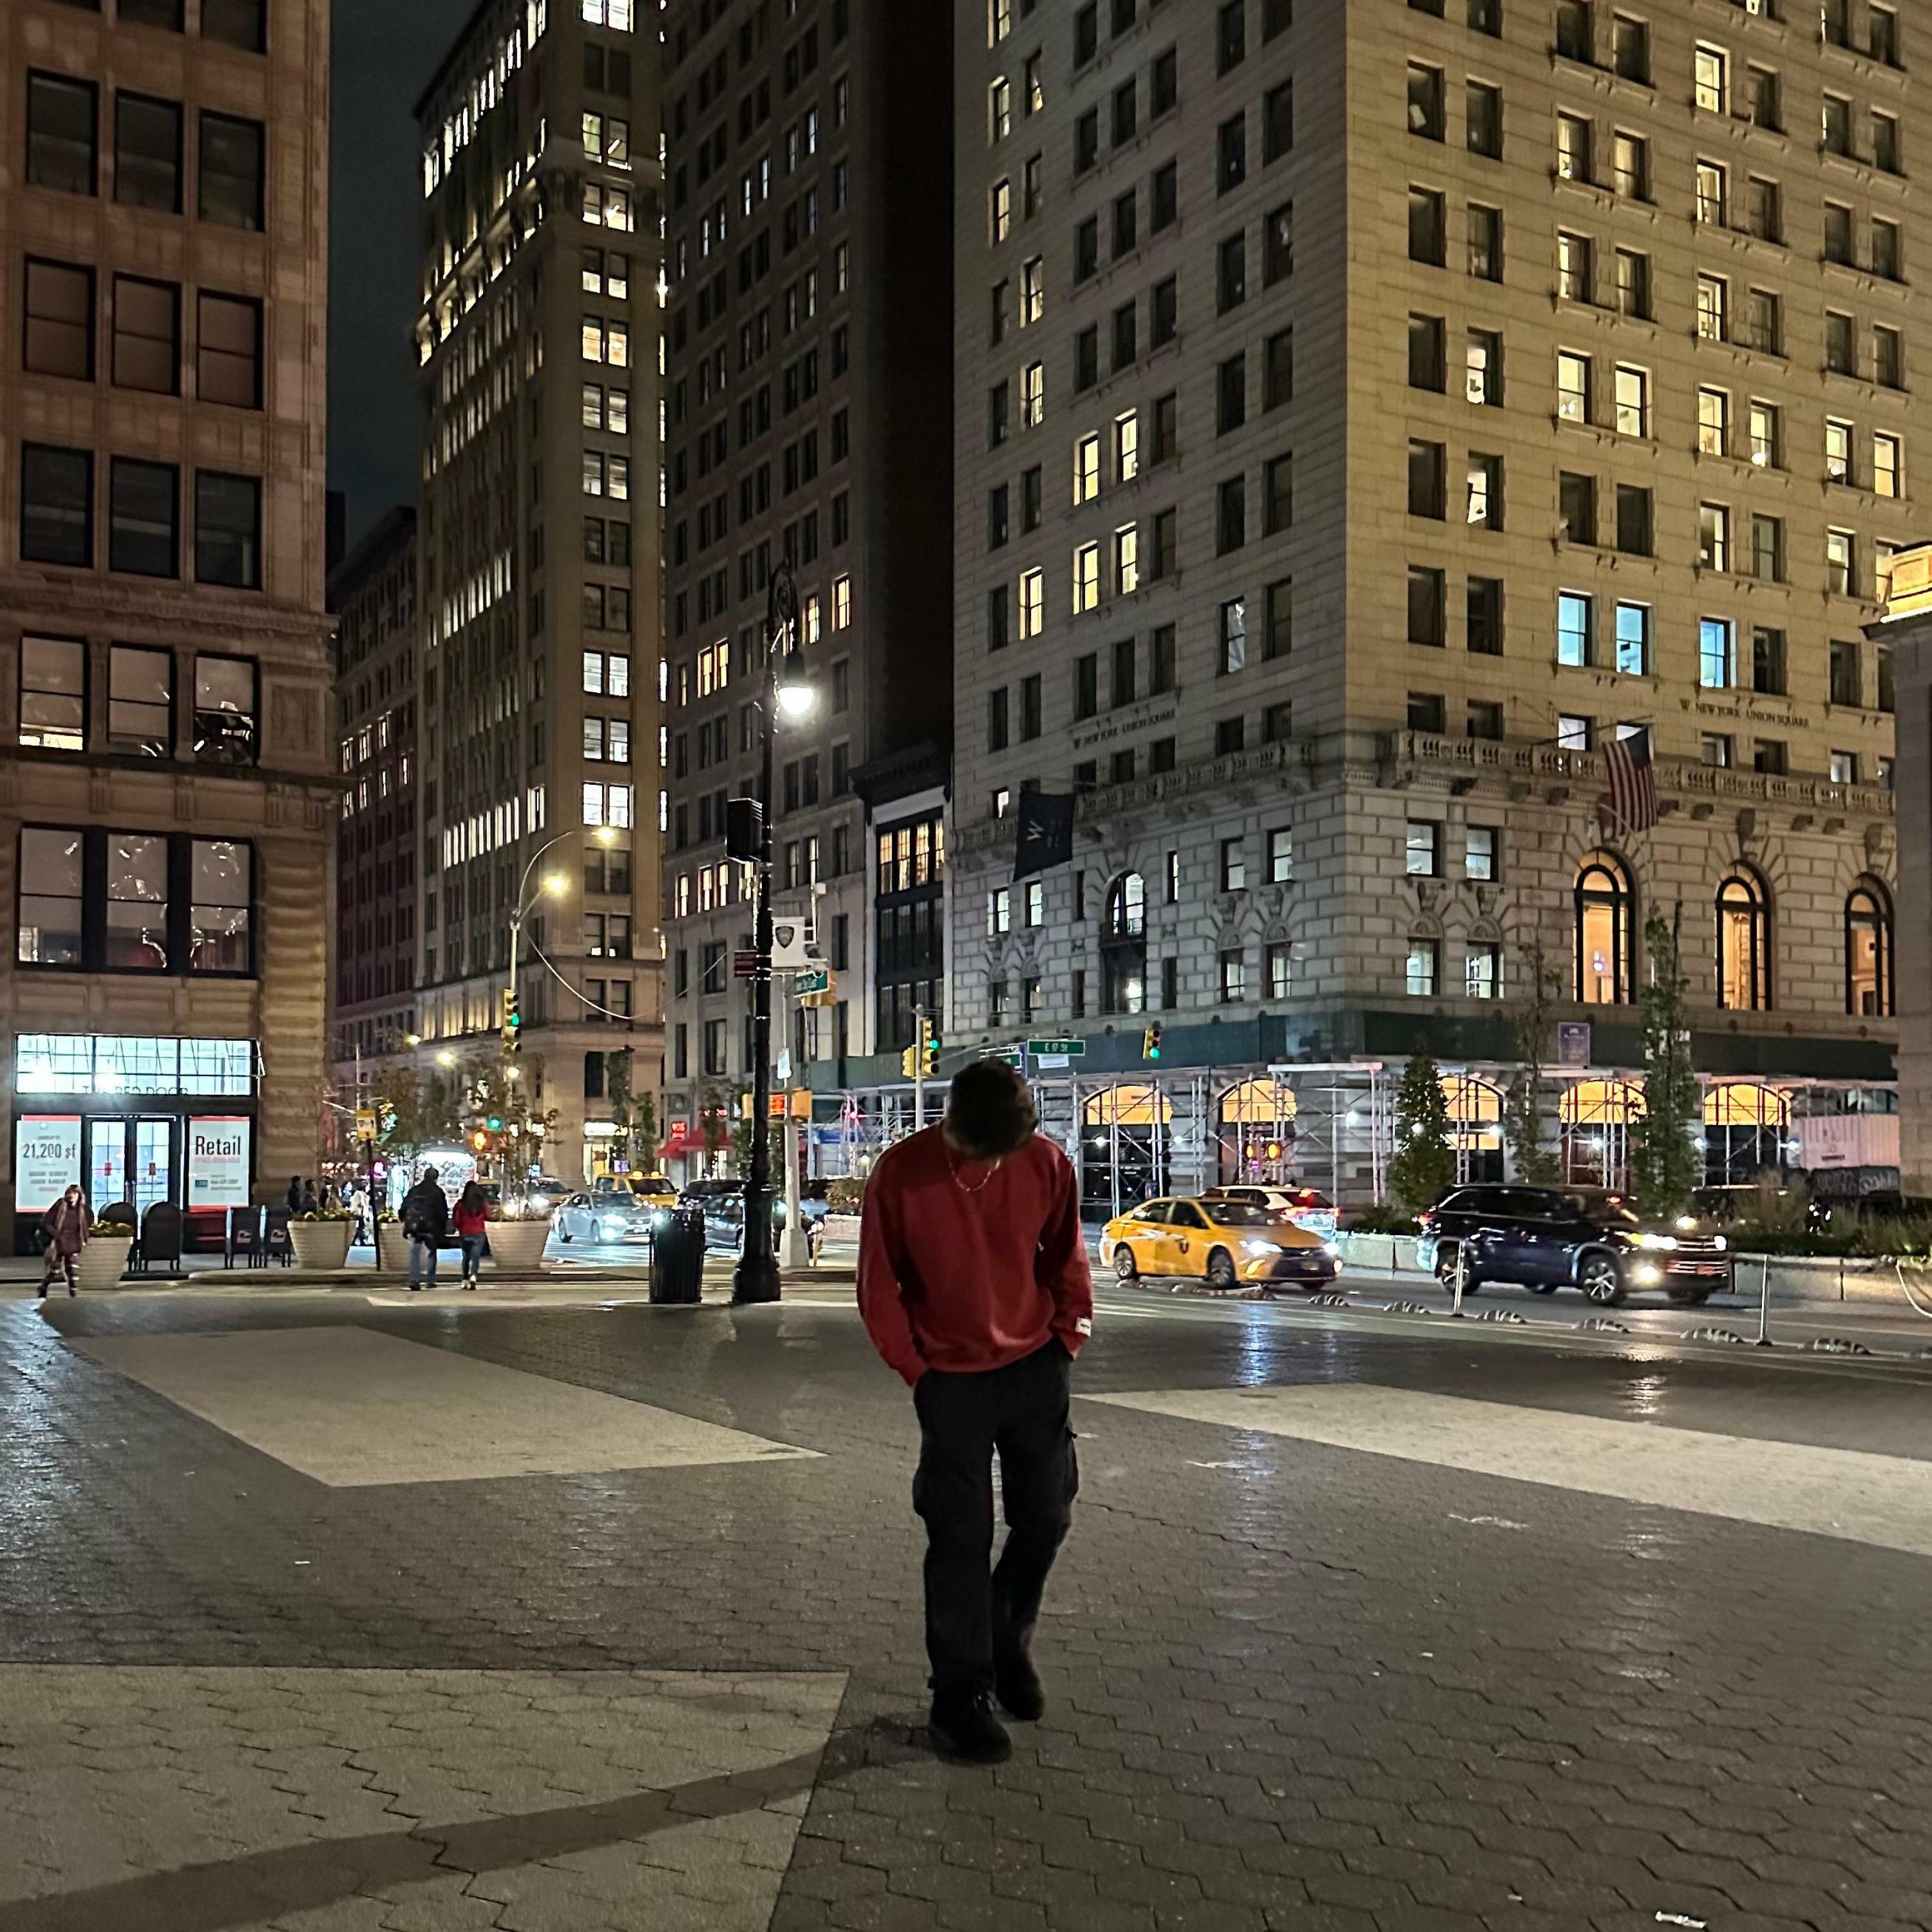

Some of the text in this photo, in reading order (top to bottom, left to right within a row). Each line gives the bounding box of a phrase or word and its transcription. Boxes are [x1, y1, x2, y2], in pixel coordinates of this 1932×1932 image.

[1680, 698, 1810, 728] W NEW YORK UNION SQUARE
[1045, 1043, 1050, 1052] E
[23, 1143, 62, 1159] 21,200
[195, 1135, 240, 1155] Retail
